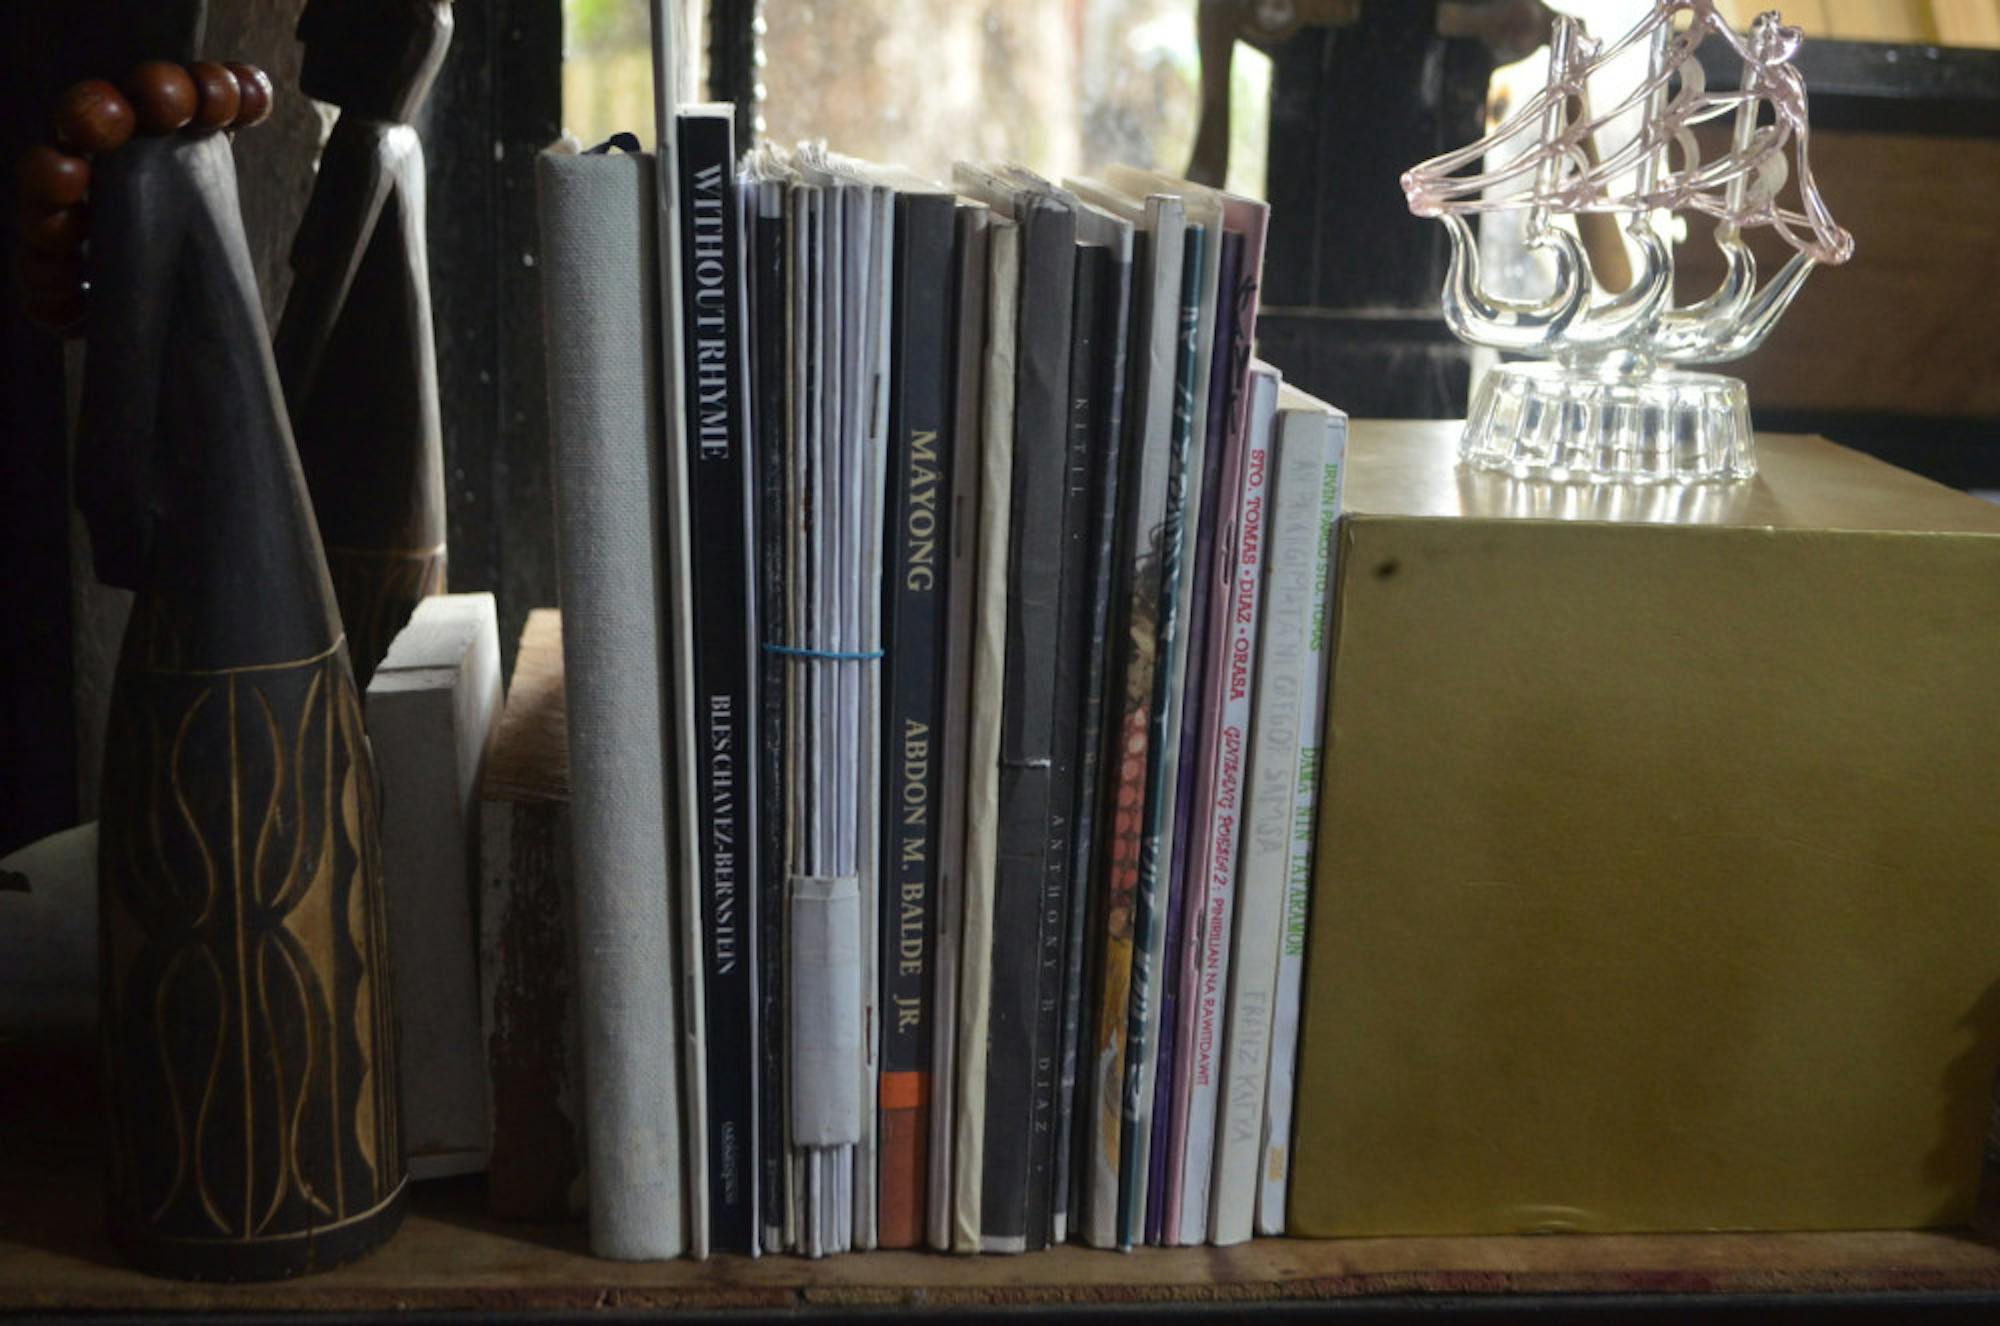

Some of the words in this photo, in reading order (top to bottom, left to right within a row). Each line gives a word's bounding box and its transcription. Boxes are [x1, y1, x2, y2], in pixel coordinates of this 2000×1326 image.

[693, 162, 726, 333] WITHOUT
[697, 338, 729, 460] RHYME
[1071, 398, 1088, 497] KITIL
[1247, 449, 1265, 492] STO.
[1321, 463, 1338, 504] IRVIN
[1242, 496, 1261, 564] TOMAS
[1236, 578, 1253, 623] DIAZ
[1315, 563, 1329, 596] STO.
[1311, 603, 1327, 651] TOMAS
[1230, 638, 1249, 701] ORASA
[710, 694, 732, 751] BLES
[903, 718, 929, 826] ABDON
[712, 752, 736, 975] CHAVEZ-BERNSTEIN
[901, 837, 926, 870] M.
[1043, 815, 1065, 969] ANTHONY
[899, 882, 925, 976] BALDE
[892, 993, 921, 1034] JR.
[1204, 972, 1216, 995] NA
[1034, 1057, 1051, 1133] DIAZ
